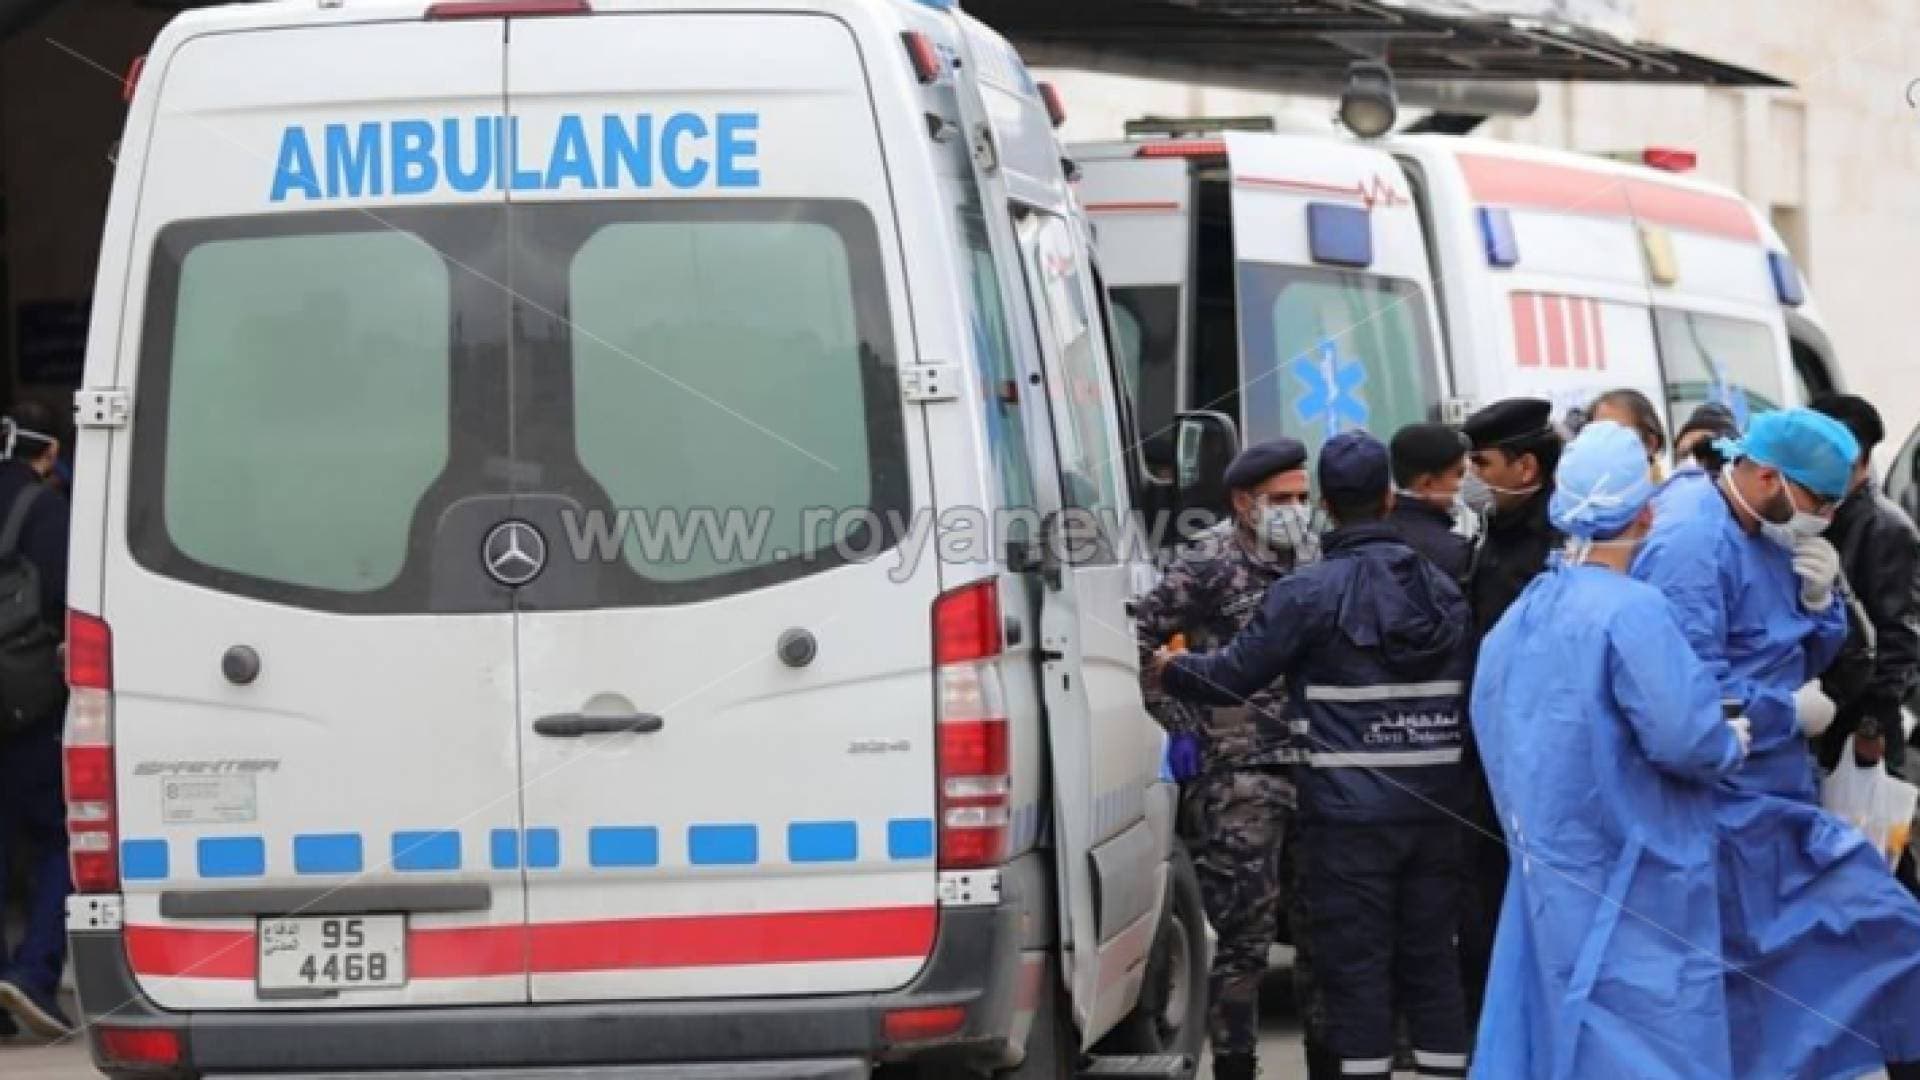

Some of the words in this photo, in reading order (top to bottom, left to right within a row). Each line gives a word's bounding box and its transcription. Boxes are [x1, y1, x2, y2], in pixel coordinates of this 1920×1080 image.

[269, 112, 760, 201] AMBULANCE
[321, 919, 365, 949] 95
[299, 952, 387, 984] 4468
